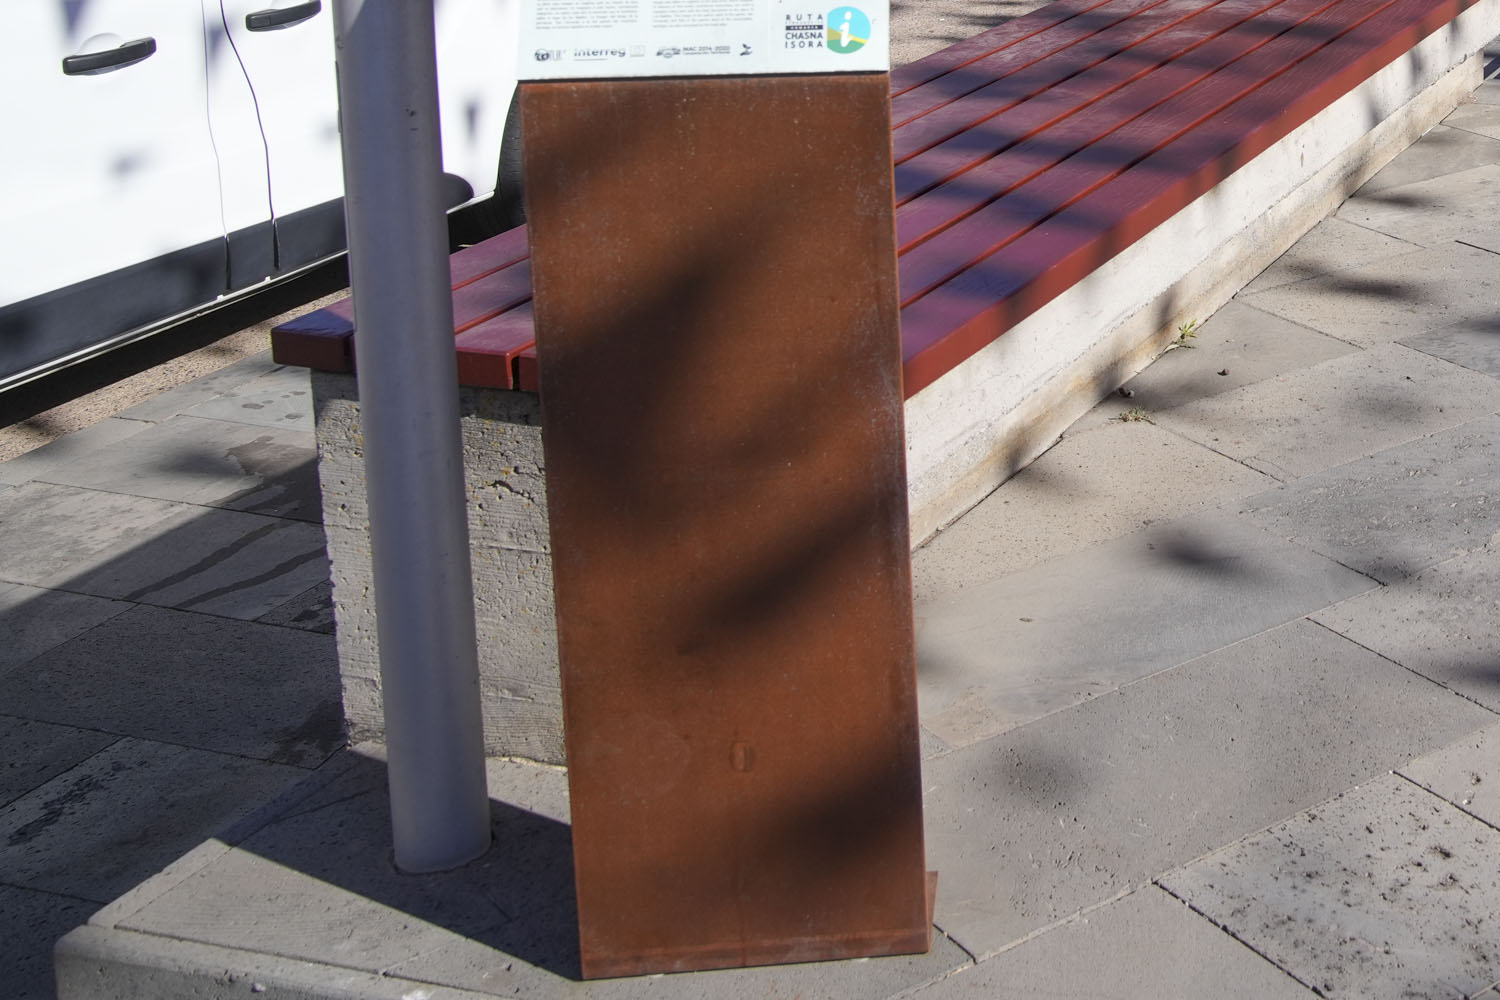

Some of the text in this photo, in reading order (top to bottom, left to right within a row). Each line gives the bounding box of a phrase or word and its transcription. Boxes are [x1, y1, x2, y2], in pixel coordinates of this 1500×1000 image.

[785, 13, 823, 21] RUTA
[785, 32, 823, 40] CHASNA
[785, 41, 823, 49] ISORA
